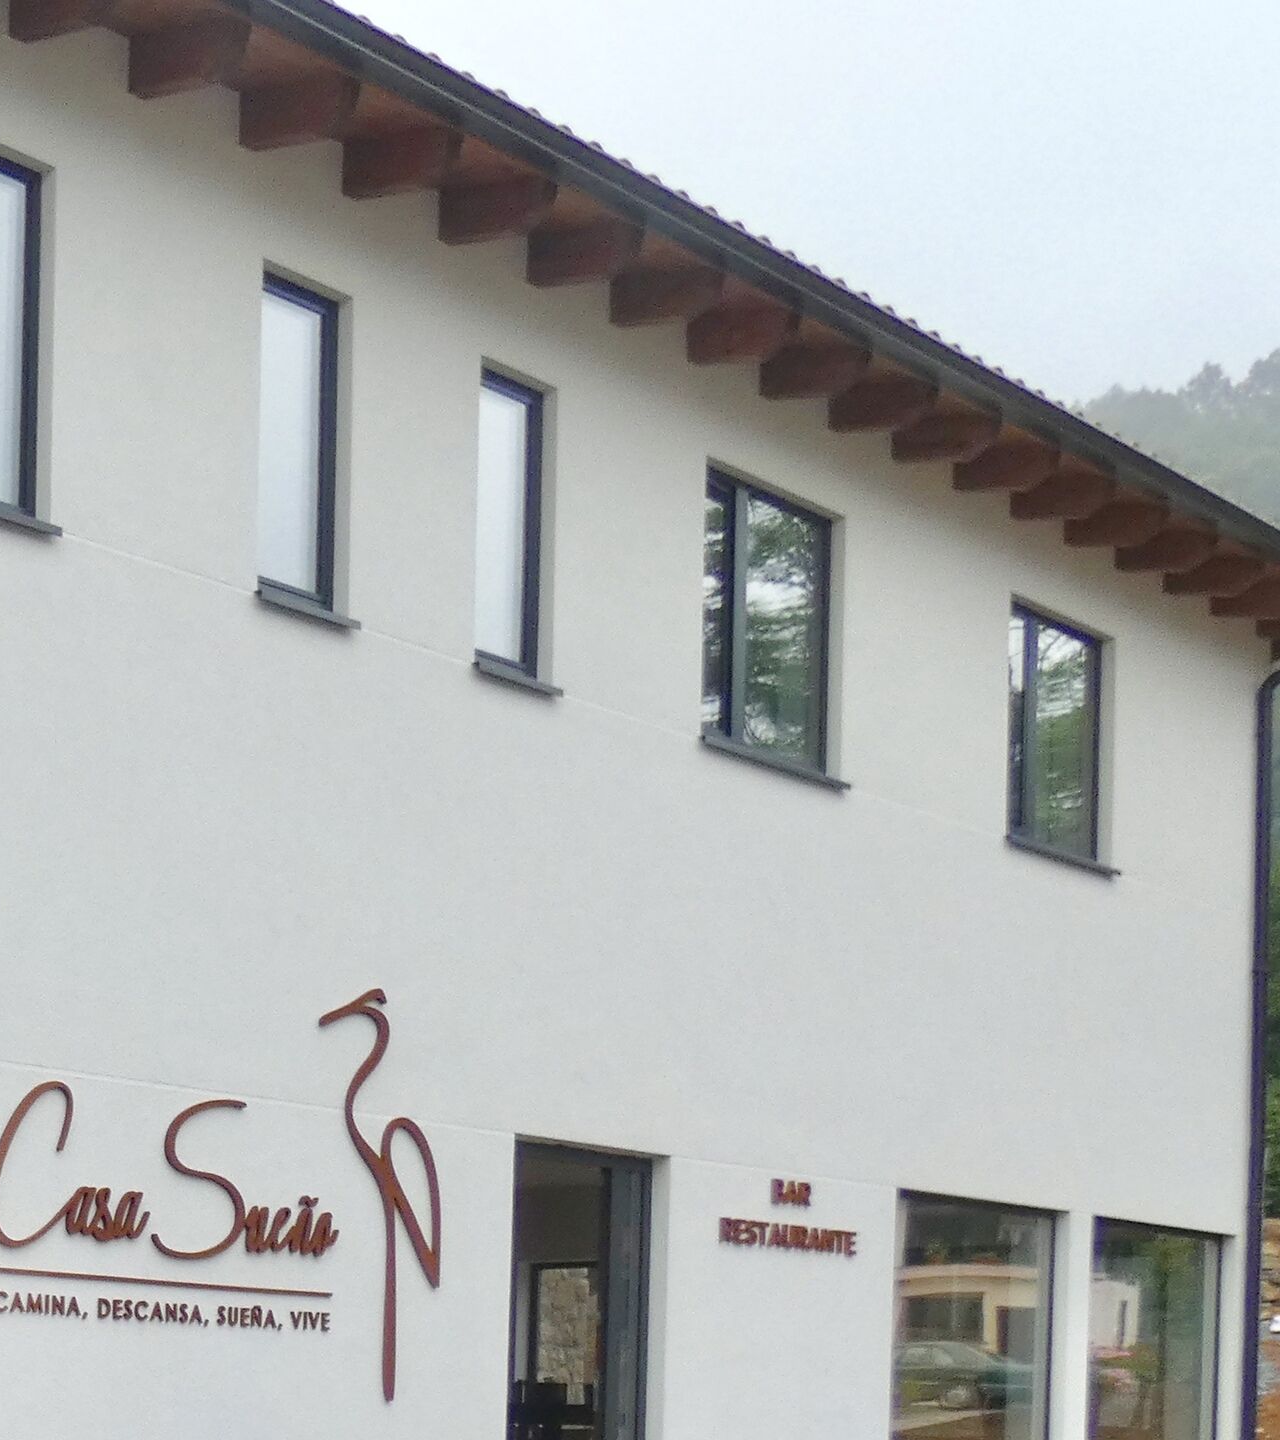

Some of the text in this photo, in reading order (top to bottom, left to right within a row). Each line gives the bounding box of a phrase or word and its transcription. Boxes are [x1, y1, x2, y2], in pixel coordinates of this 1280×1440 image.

[151, 1099, 340, 1260] Sueño
[771, 1178, 811, 1206] BAR
[719, 1217, 857, 1258] RESTAURANTE
[97, 1297, 209, 1328] DESCANSA,
[217, 1305, 283, 1331] SUEÑA,
[290, 1311, 331, 1332] VIVE
